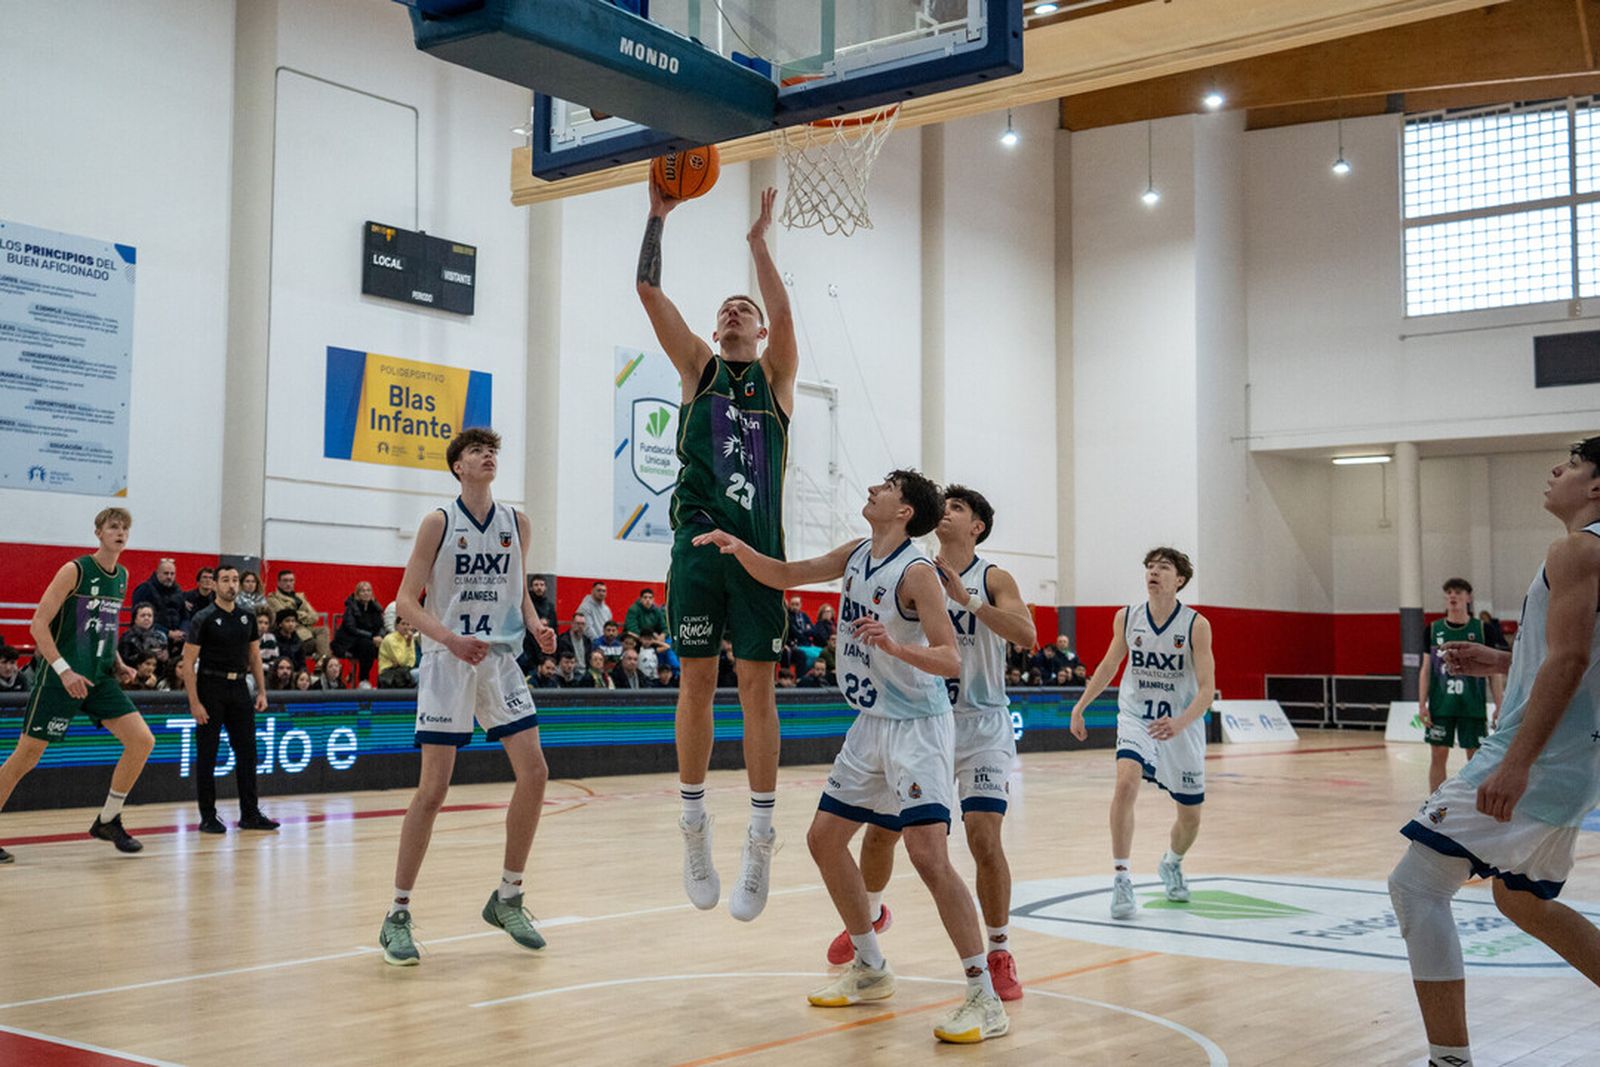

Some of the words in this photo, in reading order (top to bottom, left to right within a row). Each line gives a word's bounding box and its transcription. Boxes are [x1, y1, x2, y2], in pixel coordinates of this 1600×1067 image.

[619, 36, 680, 75] MONDO
[7, 252, 39, 268] BUEN
[41, 259, 110, 281] AFICIONADO
[24, 243, 94, 267] PRINCIPIOS
[96, 257, 116, 271] DEL
[373, 254, 404, 270] LOCAL
[380, 364, 446, 384] POLIDEPORTIVO
[389, 383, 436, 413] Blas
[370, 407, 452, 440] Infante
[725, 472, 756, 511] 23
[455, 553, 511, 576] BAXI
[459, 613, 492, 636] 14
[96, 639, 105, 658] 1
[1131, 650, 1185, 672] BAXI
[844, 672, 878, 709] 23
[1446, 679, 1465, 695] 20
[326, 727, 358, 770] e
[974, 773, 991, 783] ETL
